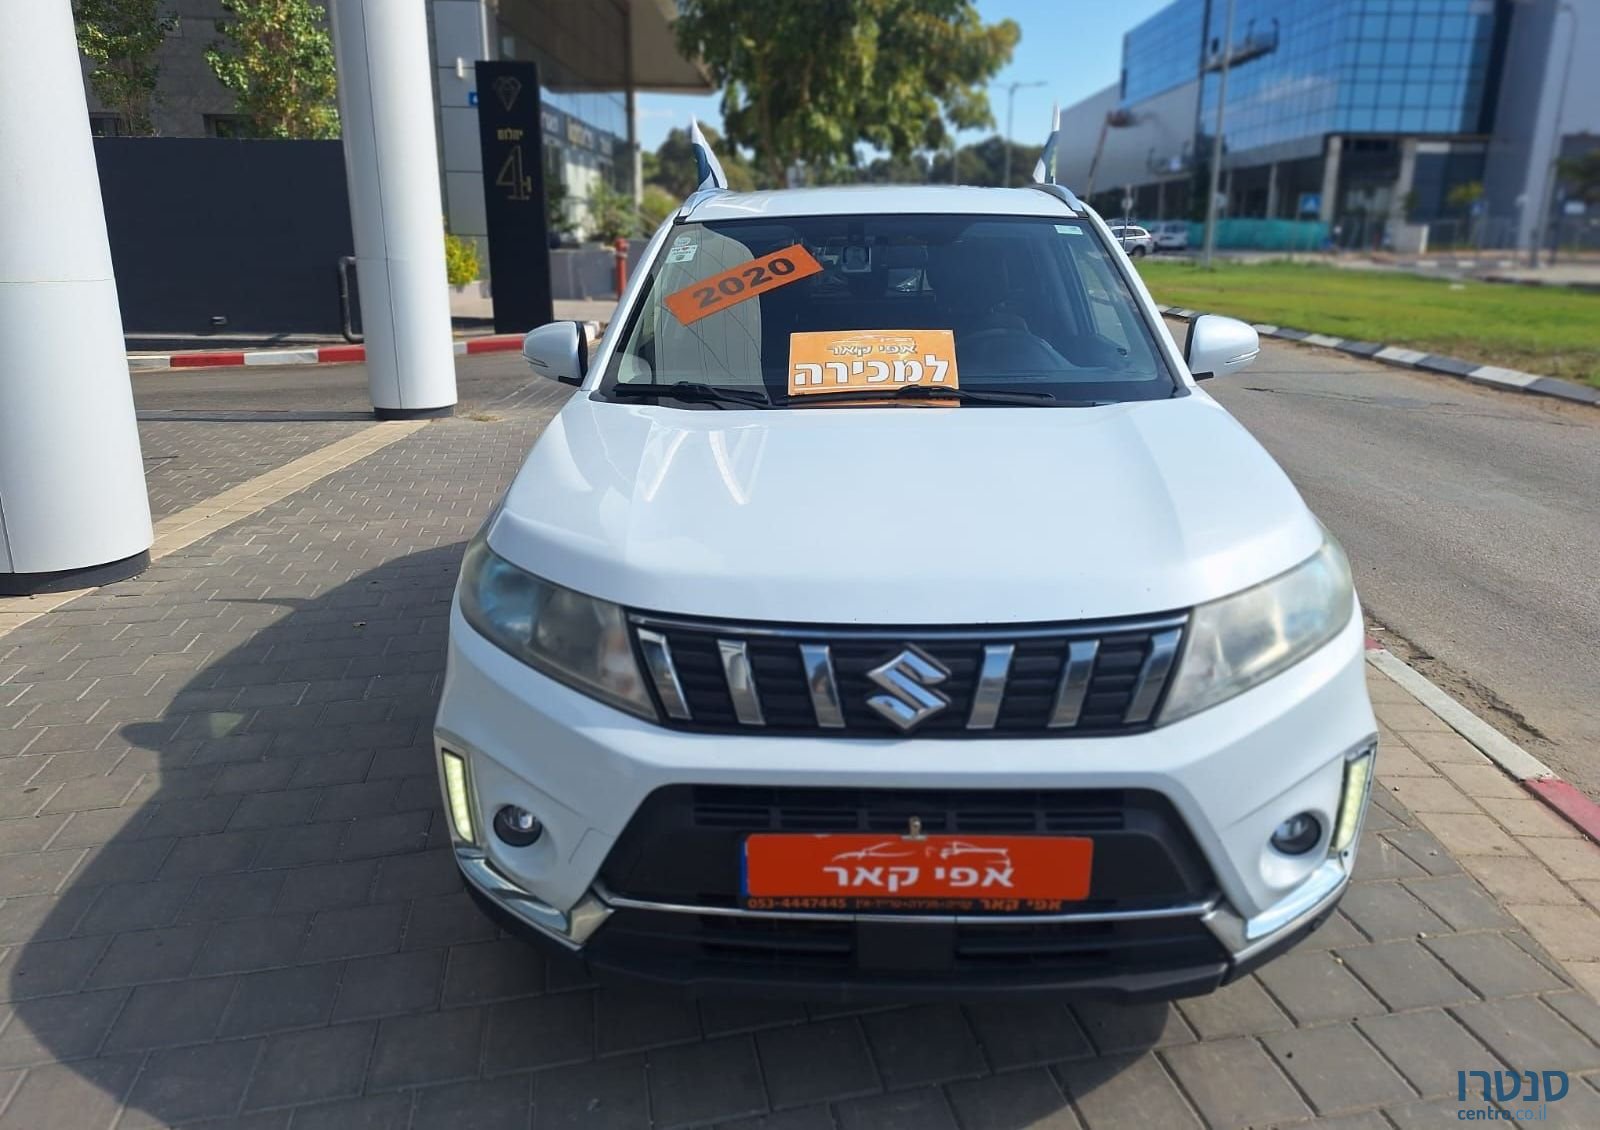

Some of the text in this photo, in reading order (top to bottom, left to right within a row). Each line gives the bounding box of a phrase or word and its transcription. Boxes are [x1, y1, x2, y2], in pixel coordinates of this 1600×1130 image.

[692, 256, 796, 309] 2020
[879, 344, 918, 355] אפי
[793, 354, 950, 386] למכירה
[823, 866, 1015, 893] אפי קאר
[747, 897, 848, 911] 053-4447445
[979, 898, 1019, 913] קאר
[1028, 898, 1063, 912] אפי
